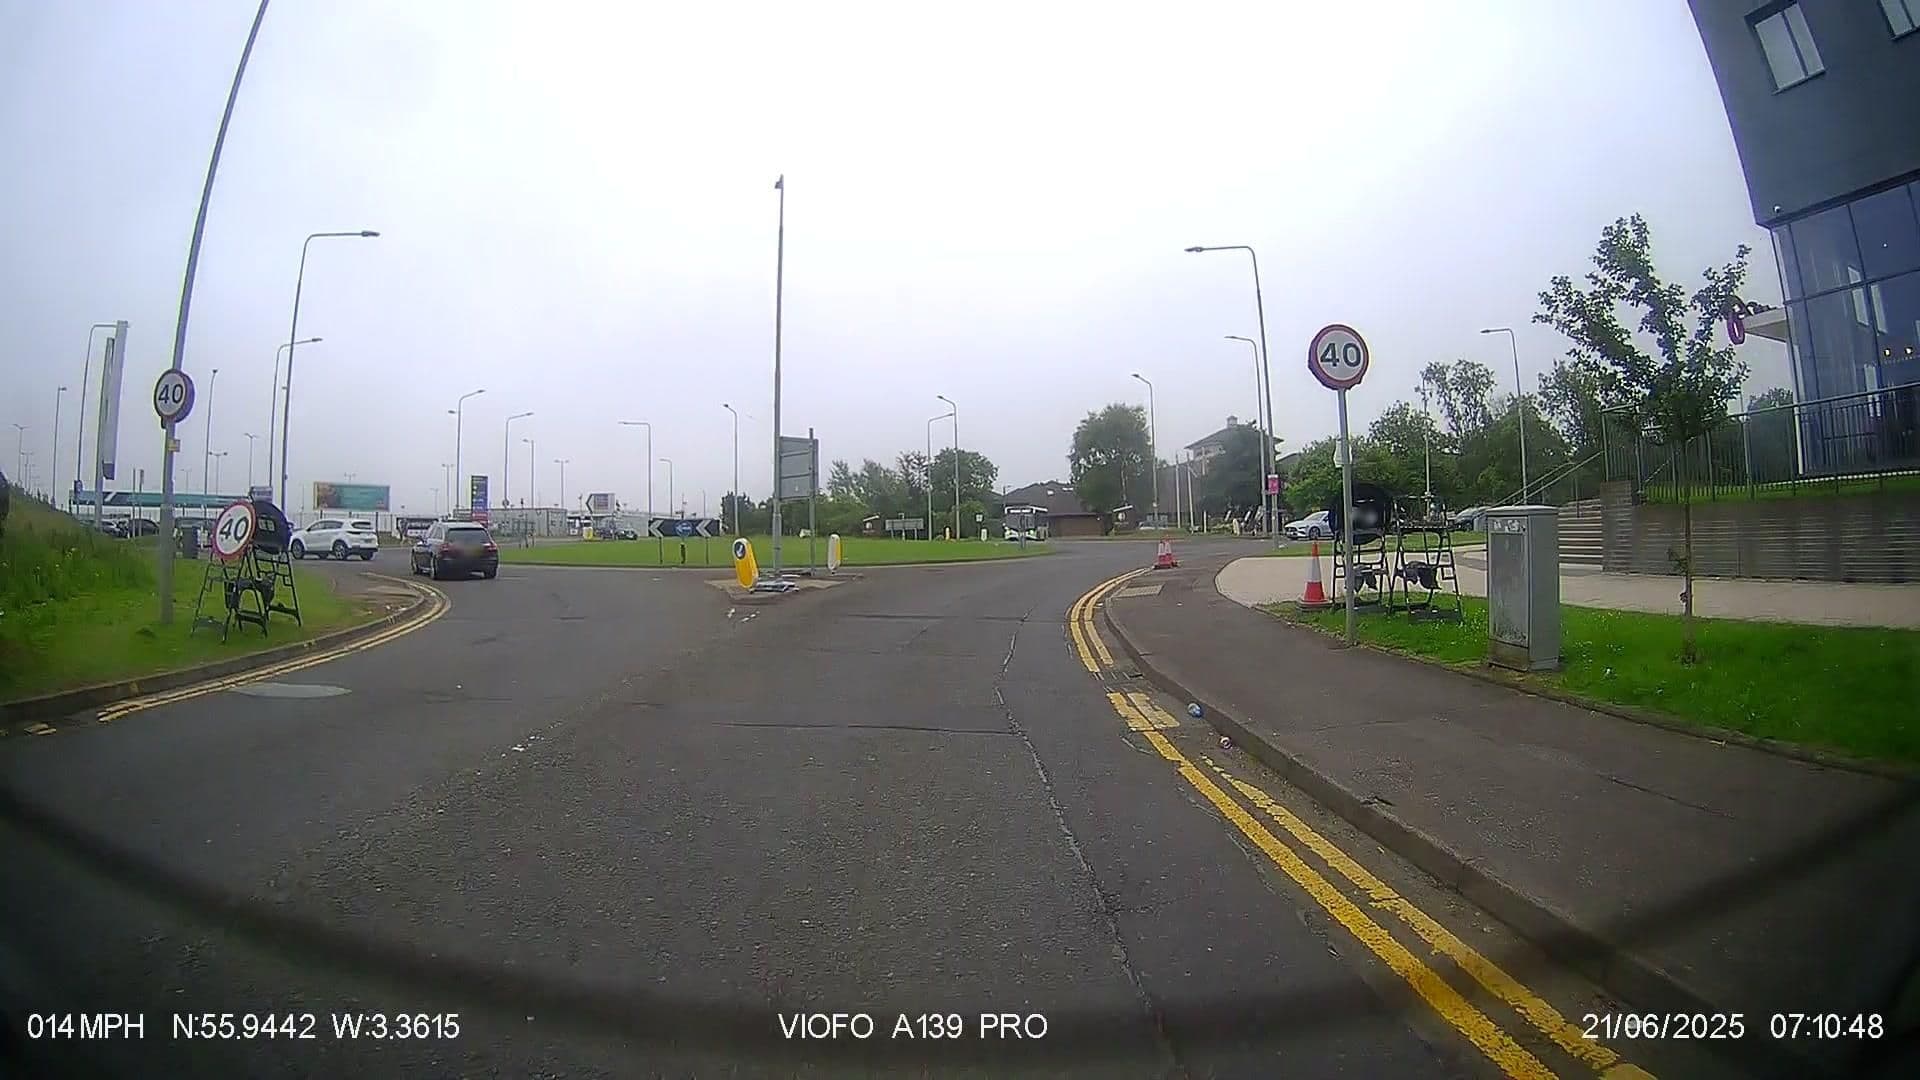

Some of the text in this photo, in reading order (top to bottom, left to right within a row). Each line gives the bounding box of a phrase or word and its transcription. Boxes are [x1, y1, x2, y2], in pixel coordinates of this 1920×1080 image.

[1319, 342, 1362, 368] 40
[157, 383, 185, 404] 40
[219, 516, 250, 543] 40
